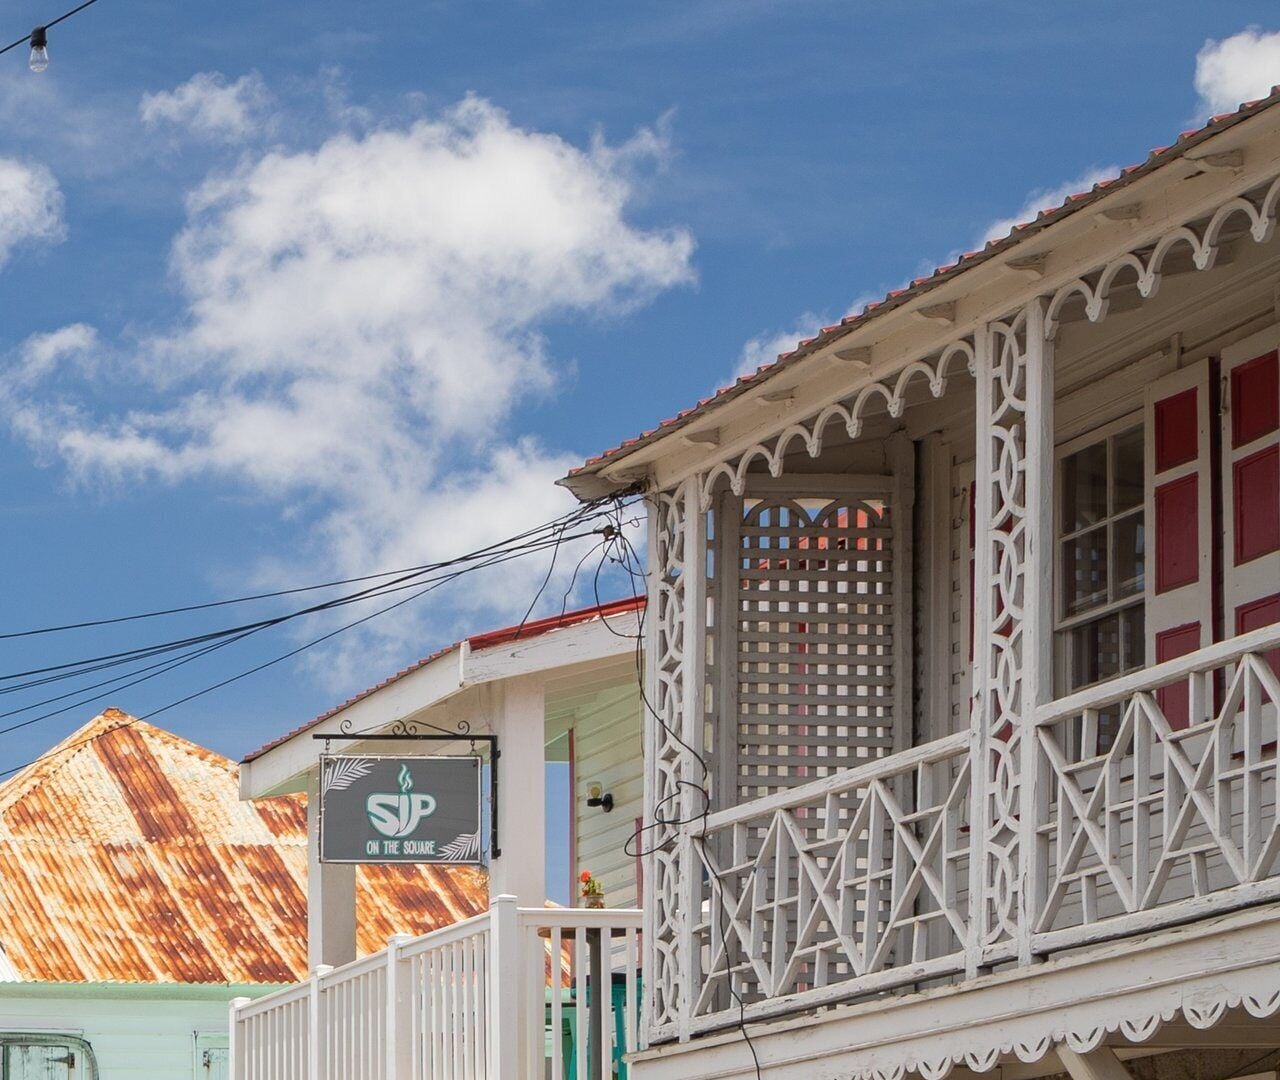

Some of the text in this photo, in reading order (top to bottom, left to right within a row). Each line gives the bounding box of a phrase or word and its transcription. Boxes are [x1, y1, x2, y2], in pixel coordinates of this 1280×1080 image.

[366, 793, 437, 838] SIP
[366, 840, 436, 855] ON THE SQUARE
